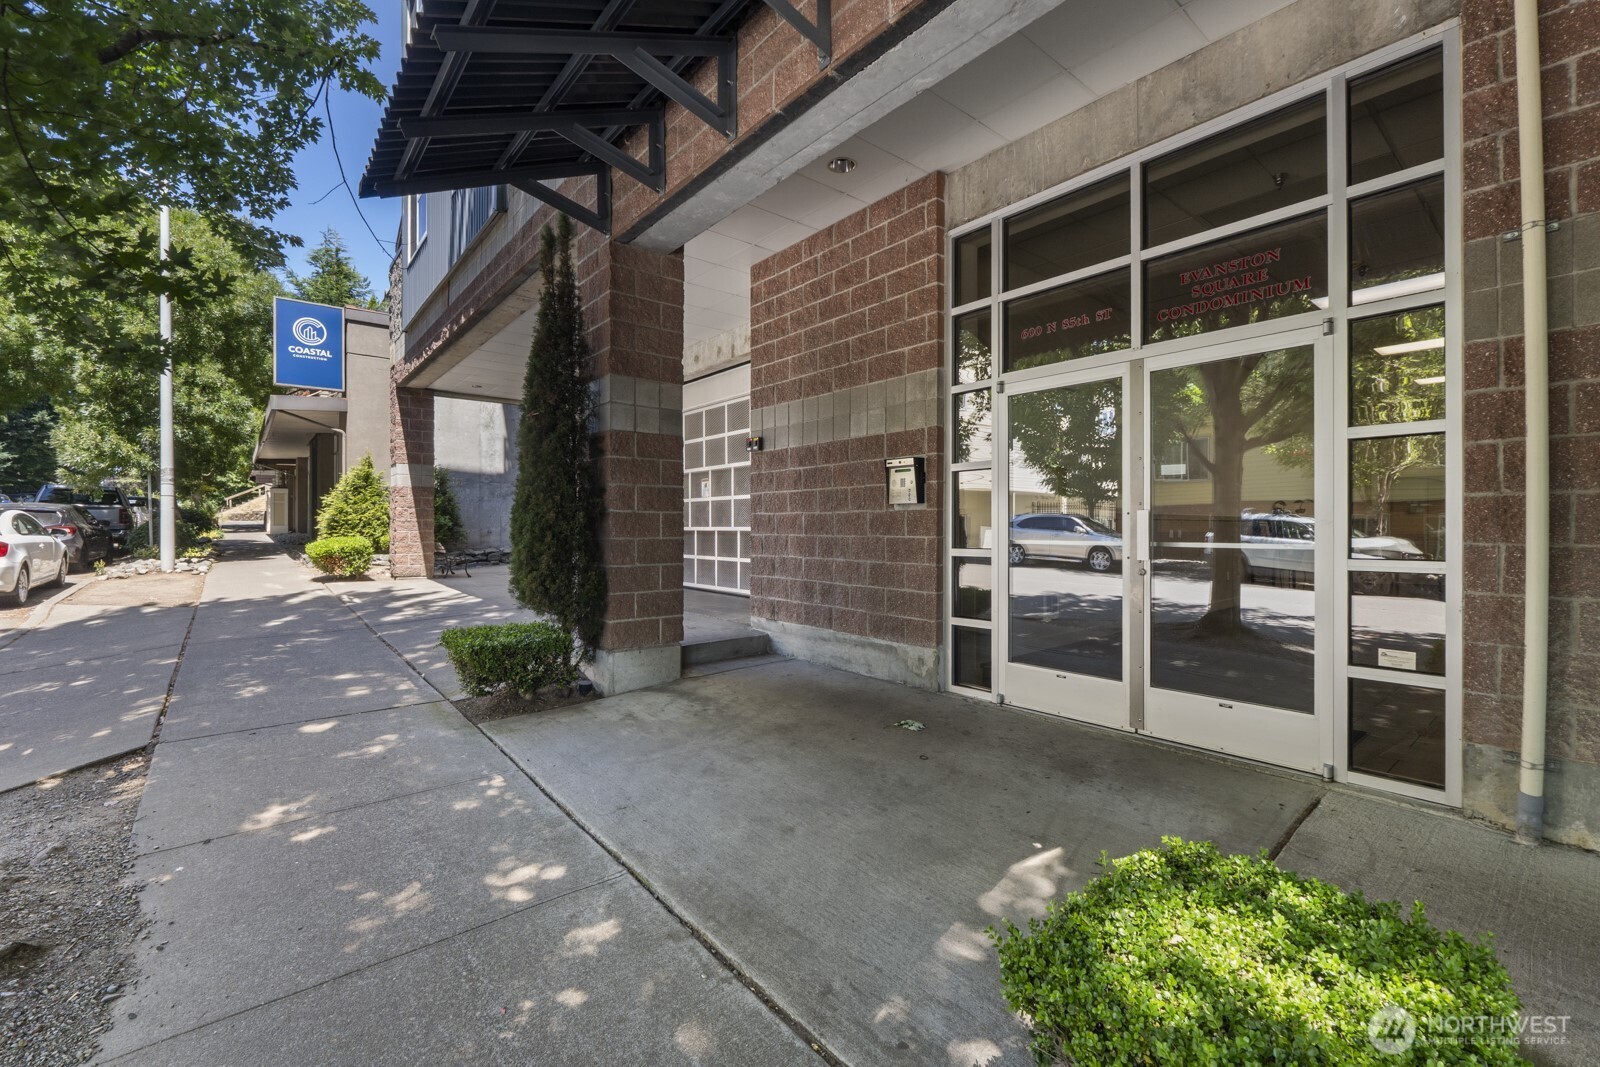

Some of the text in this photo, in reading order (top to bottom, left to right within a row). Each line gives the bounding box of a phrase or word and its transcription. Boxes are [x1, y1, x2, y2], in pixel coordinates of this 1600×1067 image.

[1179, 248, 1282, 286] EVANSTON
[1191, 268, 1269, 298] SQUARE
[1156, 275, 1312, 322] CONDOMINIUM
[1020, 325, 1043, 341] 600
[1046, 321, 1058, 334] N
[1095, 307, 1113, 323] ST
[288, 345, 333, 358] COASTAL
[293, 353, 327, 361] CONSTRUCTION
